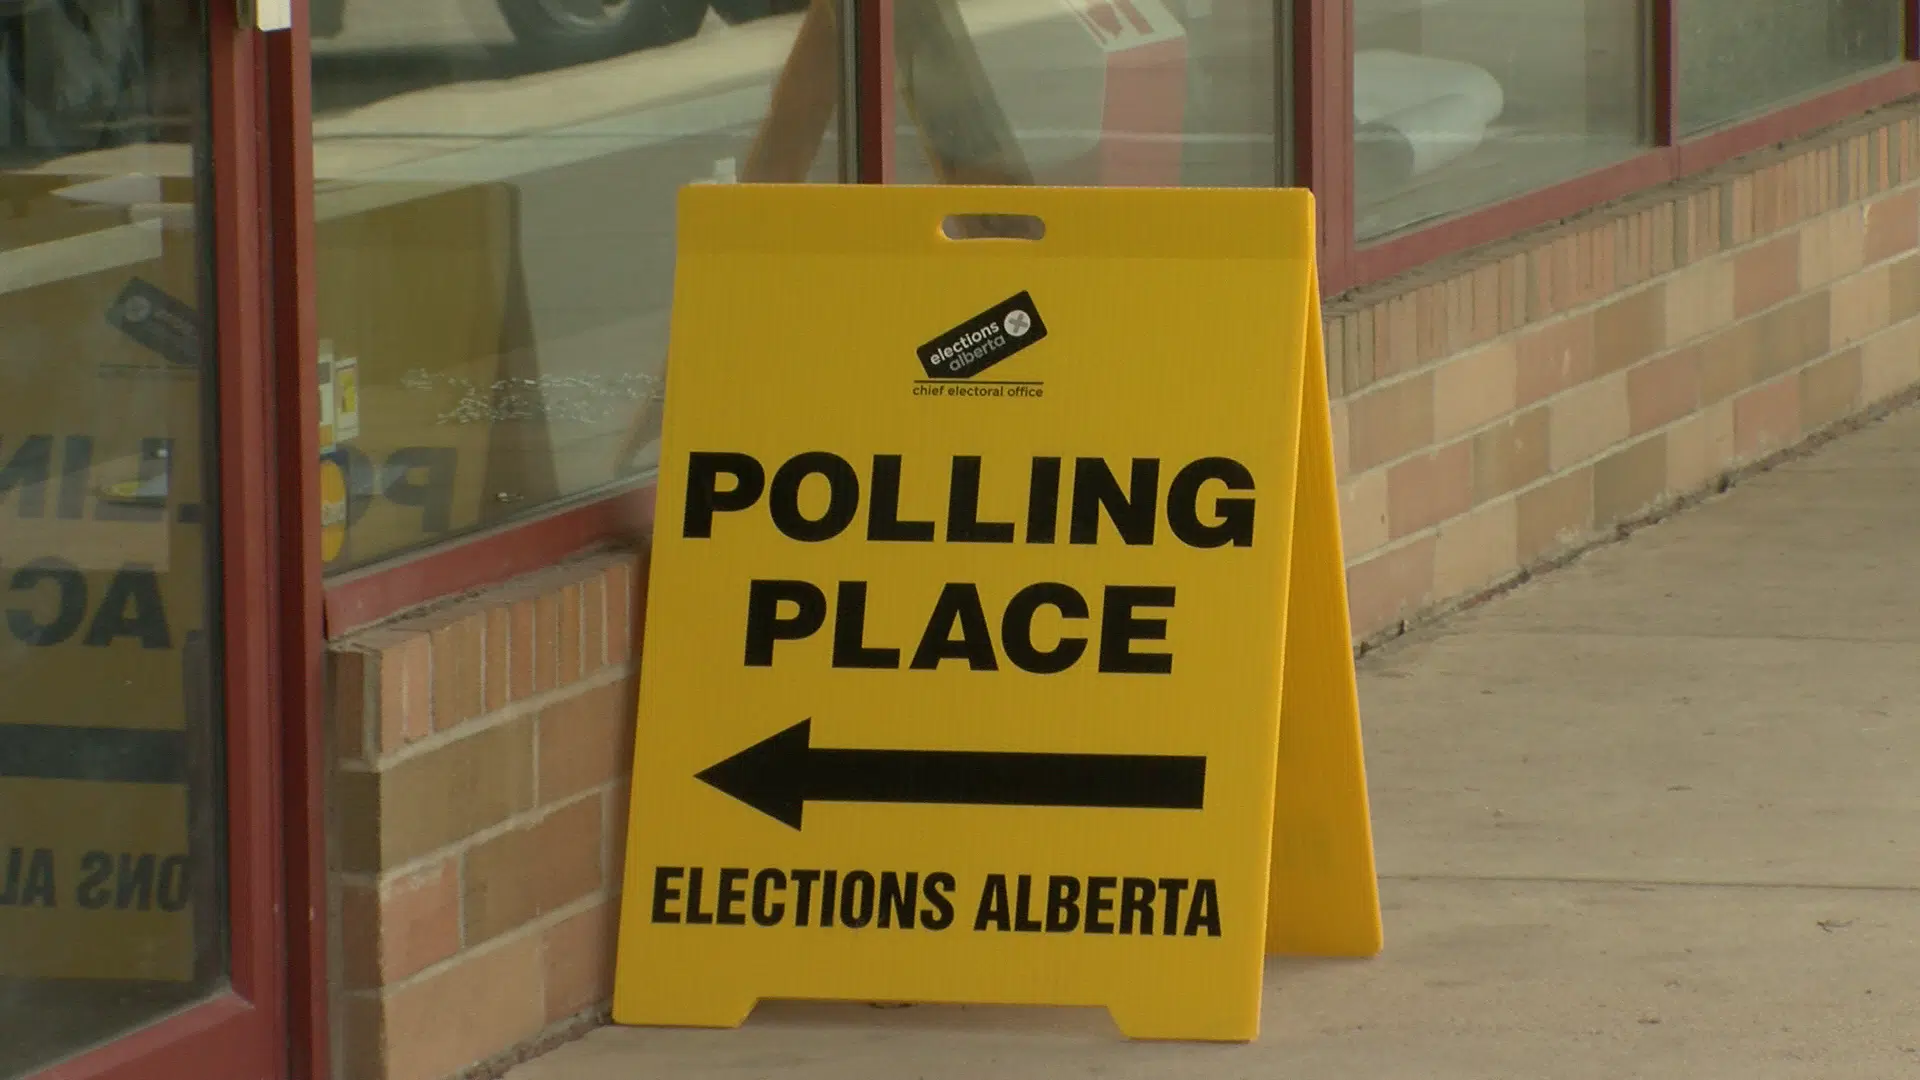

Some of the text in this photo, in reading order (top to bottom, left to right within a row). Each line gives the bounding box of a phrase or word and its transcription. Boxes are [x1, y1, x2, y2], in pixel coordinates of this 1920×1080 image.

[929, 320, 1000, 366] elections
[948, 334, 1007, 372] alberta
[912, 384, 1044, 398] chief electoral office
[683, 451, 1256, 548] POLLING
[745, 580, 1175, 673] PLACE
[652, 866, 1221, 937] ELECTIONS ALBERTA
